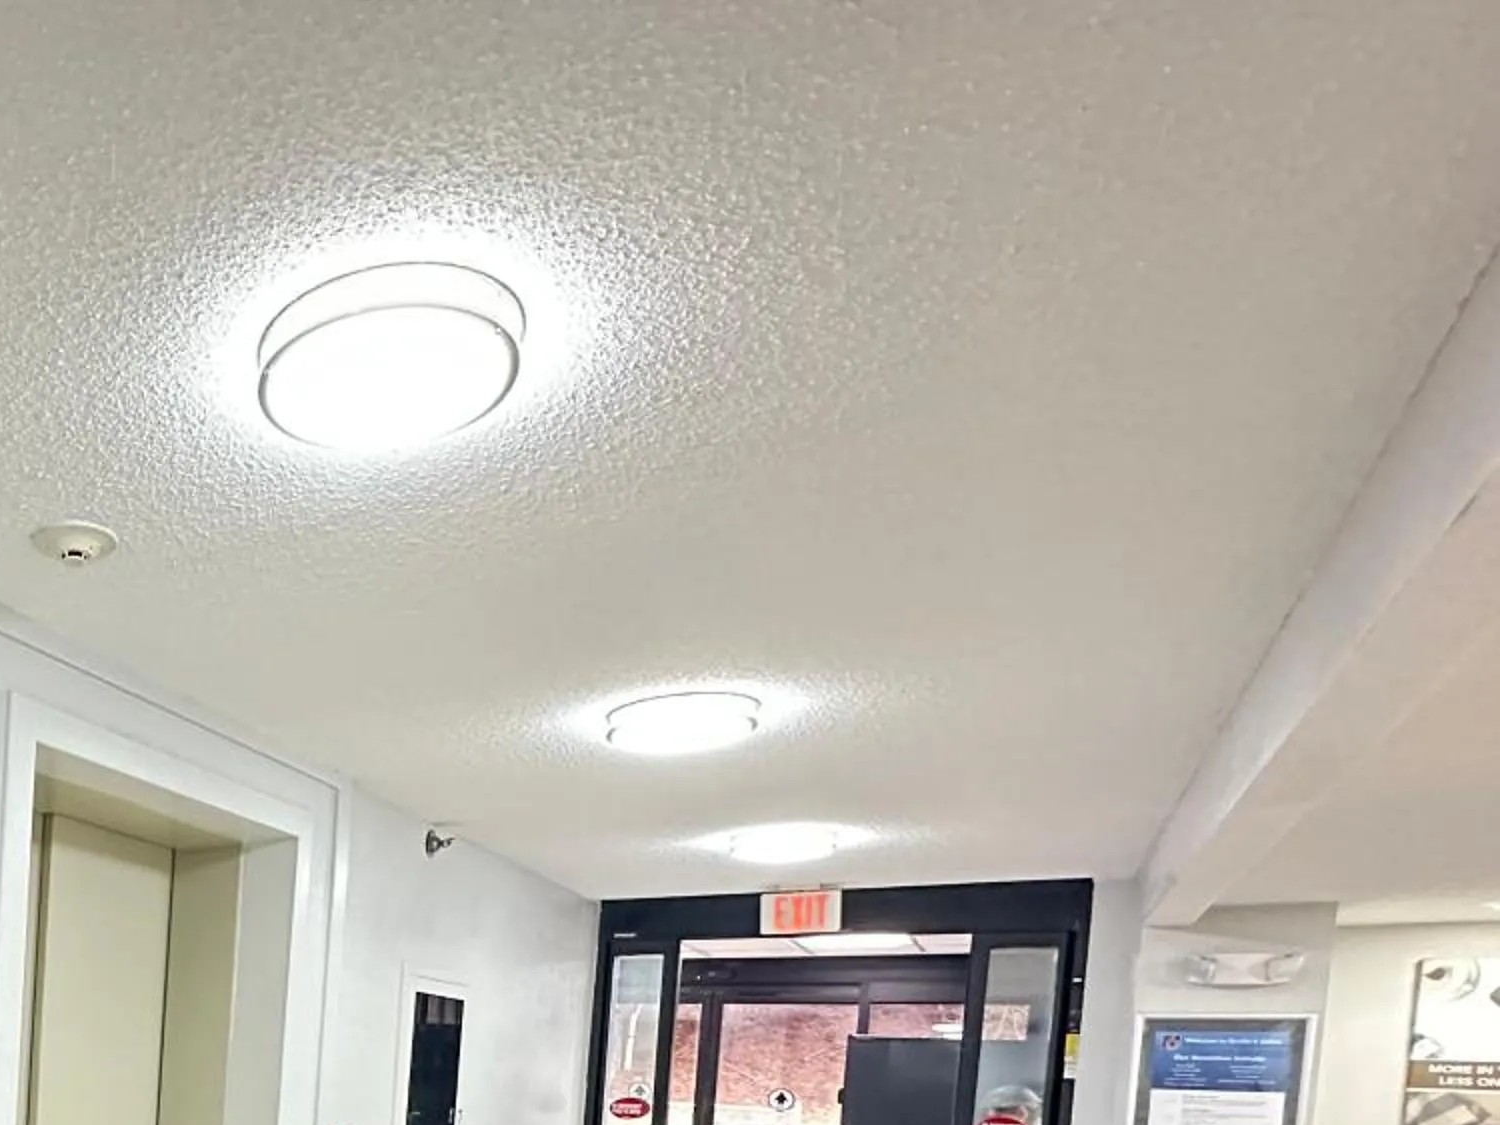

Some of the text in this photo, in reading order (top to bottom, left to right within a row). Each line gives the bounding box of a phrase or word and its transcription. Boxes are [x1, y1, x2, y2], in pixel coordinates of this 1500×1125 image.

[773, 894, 828, 930] EXIT
[1427, 1063, 1494, 1075] MORE IN
[1439, 1075, 1474, 1086] LESS
